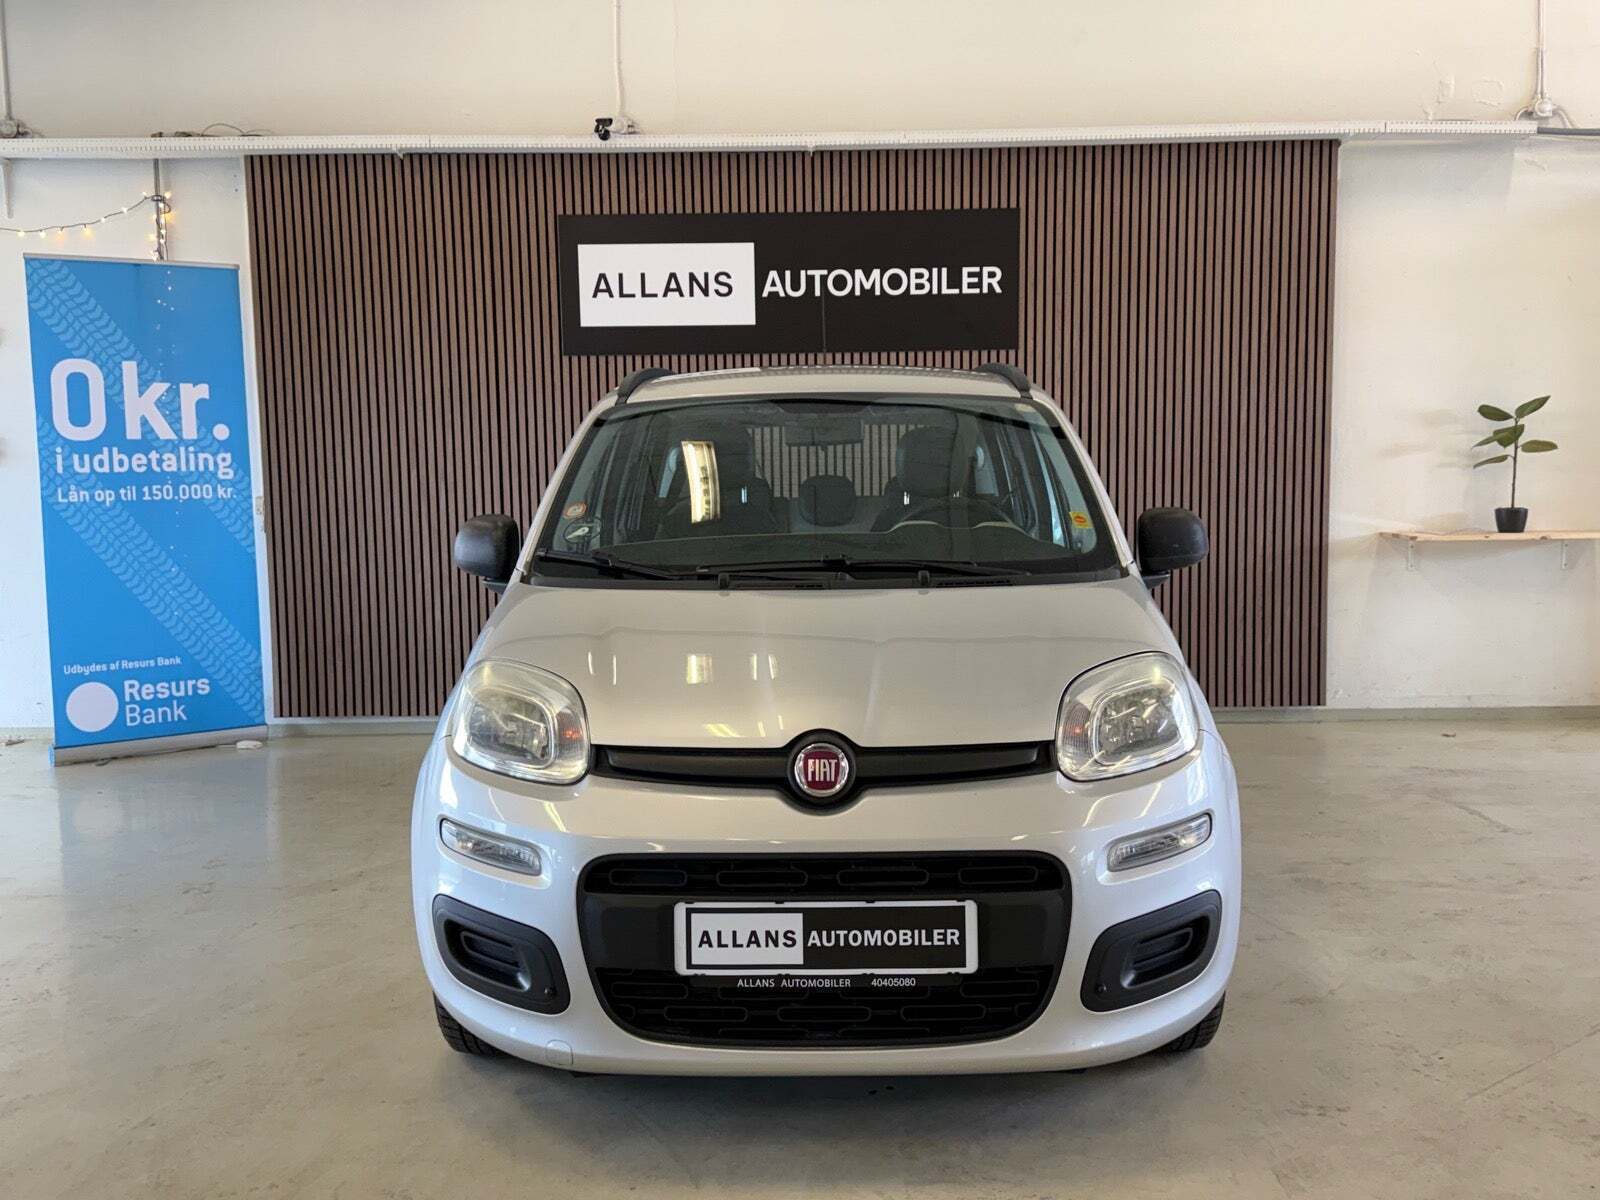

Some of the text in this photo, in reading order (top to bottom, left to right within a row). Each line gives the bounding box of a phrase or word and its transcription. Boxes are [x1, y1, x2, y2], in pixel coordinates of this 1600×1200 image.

[592, 266, 1003, 299] ALLANS AUTOMOBILER
[50, 358, 231, 442] 0 kr.
[55, 446, 235, 480] i udbetaling
[57, 483, 238, 506] Lån op til 150.000 kr.
[63, 656, 182, 676] Udbydes af Resurs Bank
[123, 678, 212, 702] Resurs
[125, 700, 188, 727] Bank
[807, 758, 838, 782] FIAT
[698, 928, 961, 948] ALLANS AUTOMOBILER
[736, 977, 916, 988] ALLANS AUTOMOBILER 40405080
